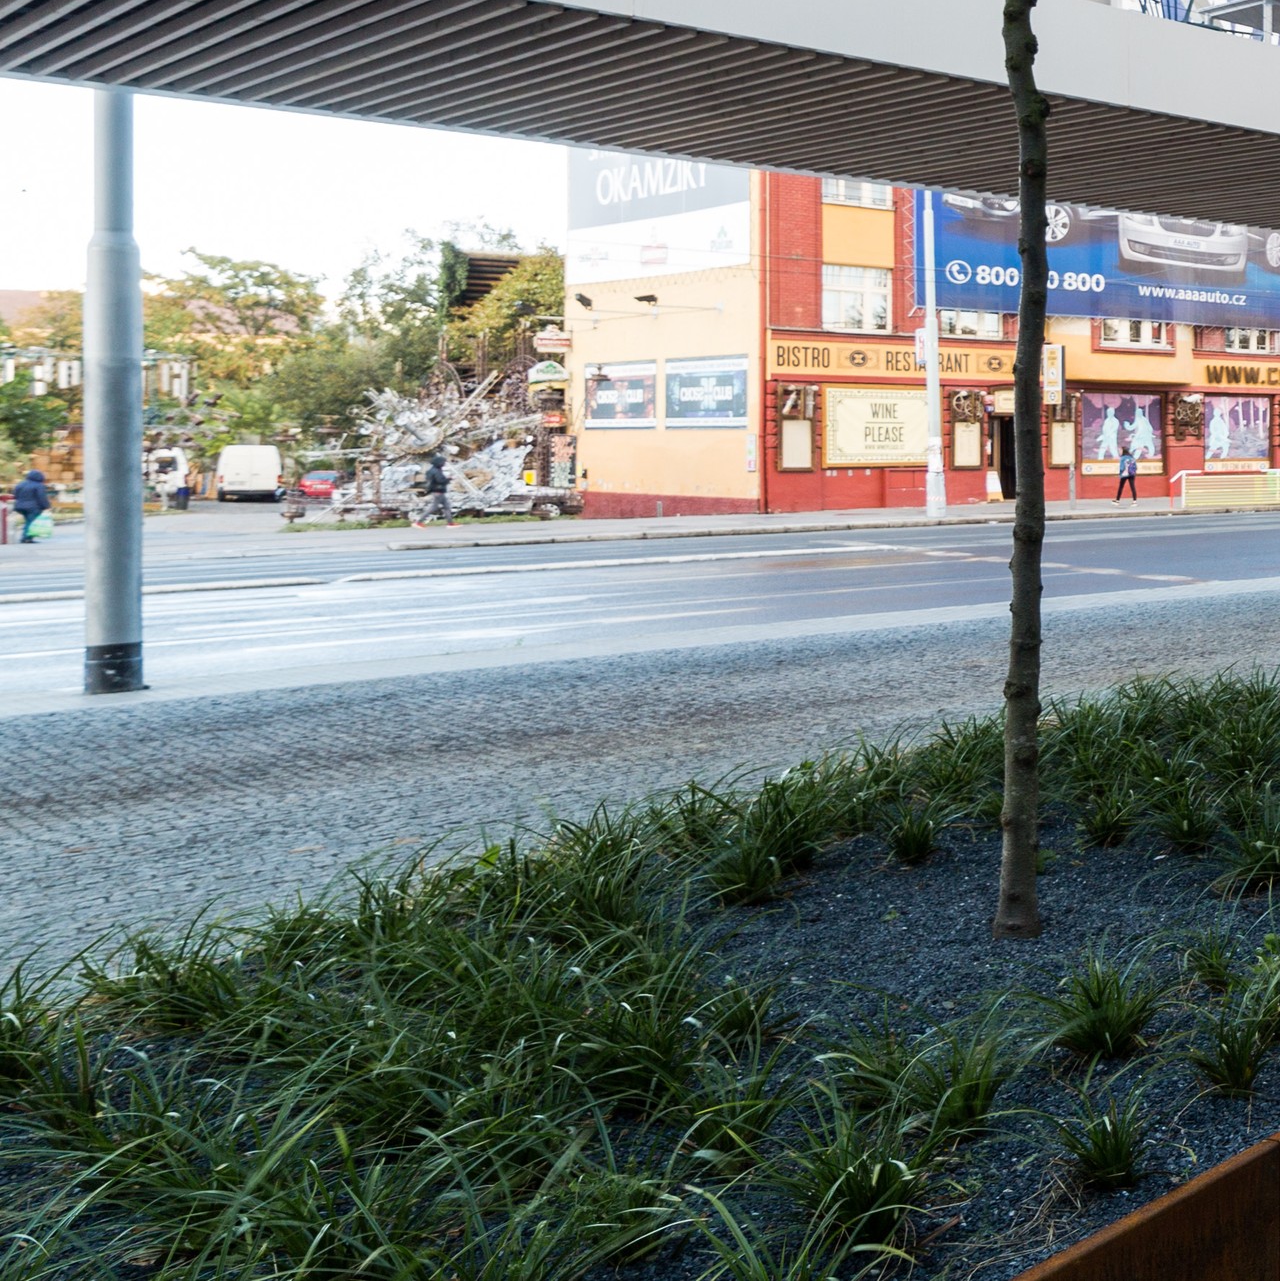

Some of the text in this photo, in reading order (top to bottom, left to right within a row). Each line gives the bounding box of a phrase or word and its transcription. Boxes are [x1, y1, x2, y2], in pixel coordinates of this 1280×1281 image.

[975, 265, 1019, 286] 800
[1063, 272, 1105, 292] 800
[1138, 285, 1247, 306] www.aaaauto.cz
[776, 345, 830, 368] BISTRO
[870, 403, 899, 419] WINE
[864, 426, 904, 443] PLEASE
